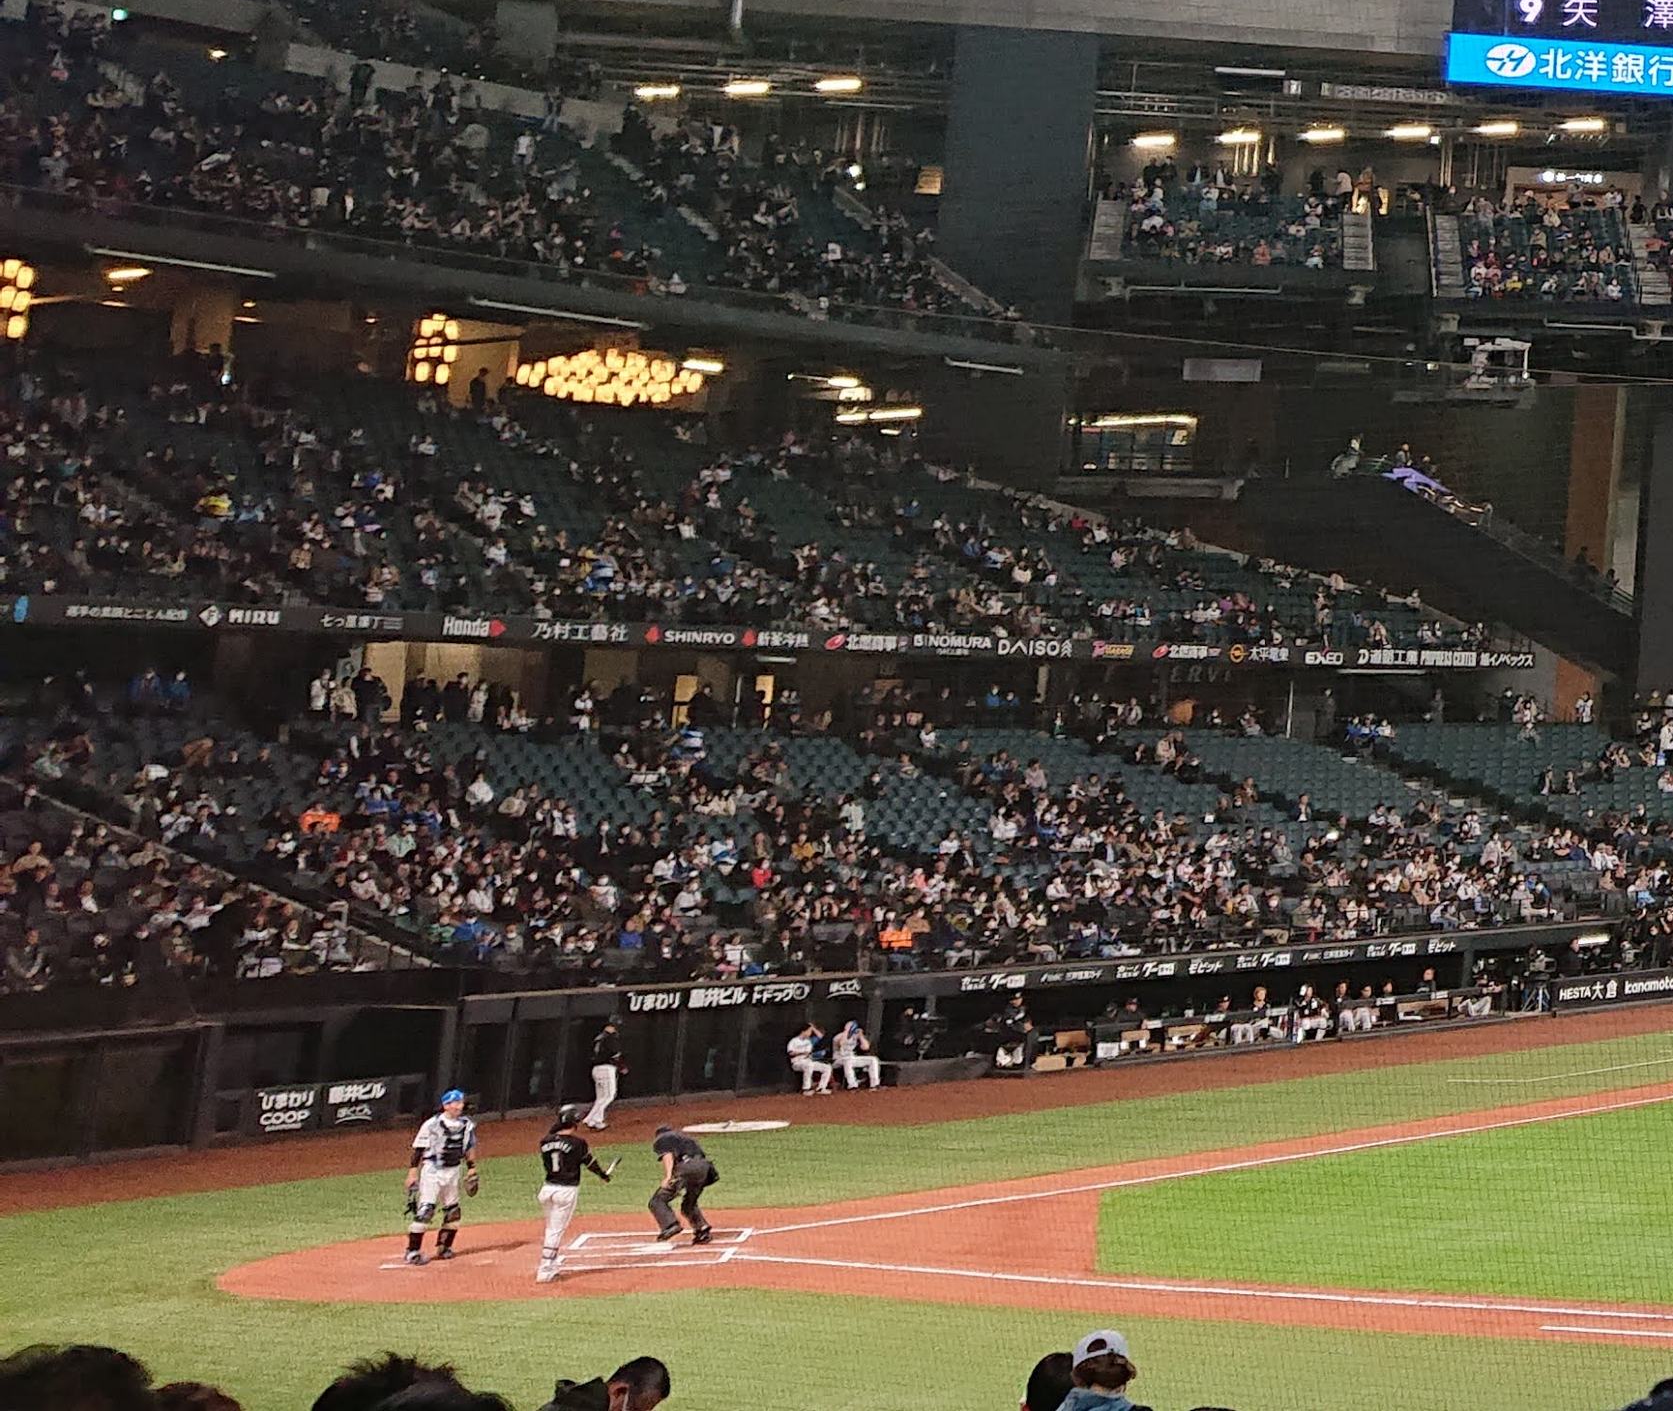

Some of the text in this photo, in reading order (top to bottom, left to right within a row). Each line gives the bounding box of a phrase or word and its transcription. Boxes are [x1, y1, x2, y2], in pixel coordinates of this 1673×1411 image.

[443, 617, 489, 636] Honda
[664, 630, 735, 644] SHINRYO
[260, 1110, 310, 1126] COOP
